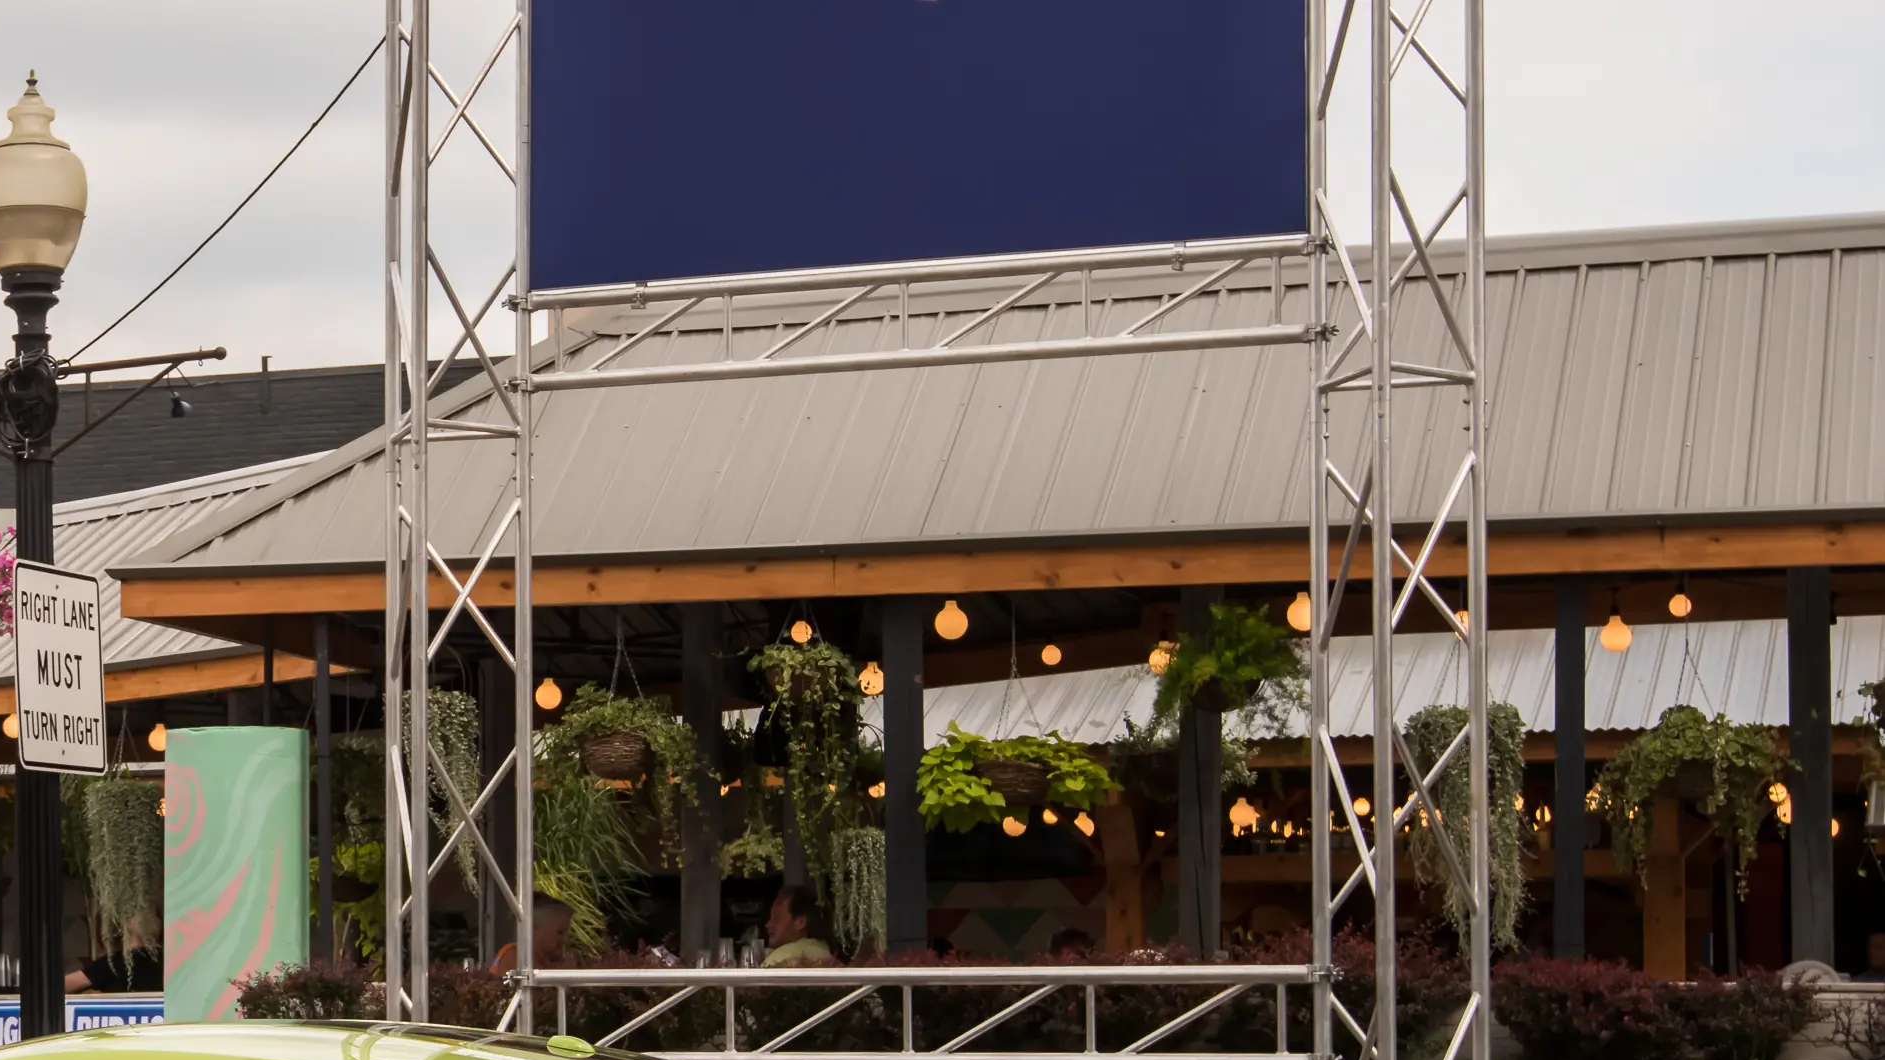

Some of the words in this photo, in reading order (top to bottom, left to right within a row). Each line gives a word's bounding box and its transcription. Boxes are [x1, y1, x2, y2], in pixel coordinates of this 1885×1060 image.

[21, 591, 57, 625] RIGHT
[63, 598, 95, 631] LANE
[37, 649, 82, 690] MUST
[24, 710, 58, 742] TURN
[63, 714, 99, 746] RIGHT
